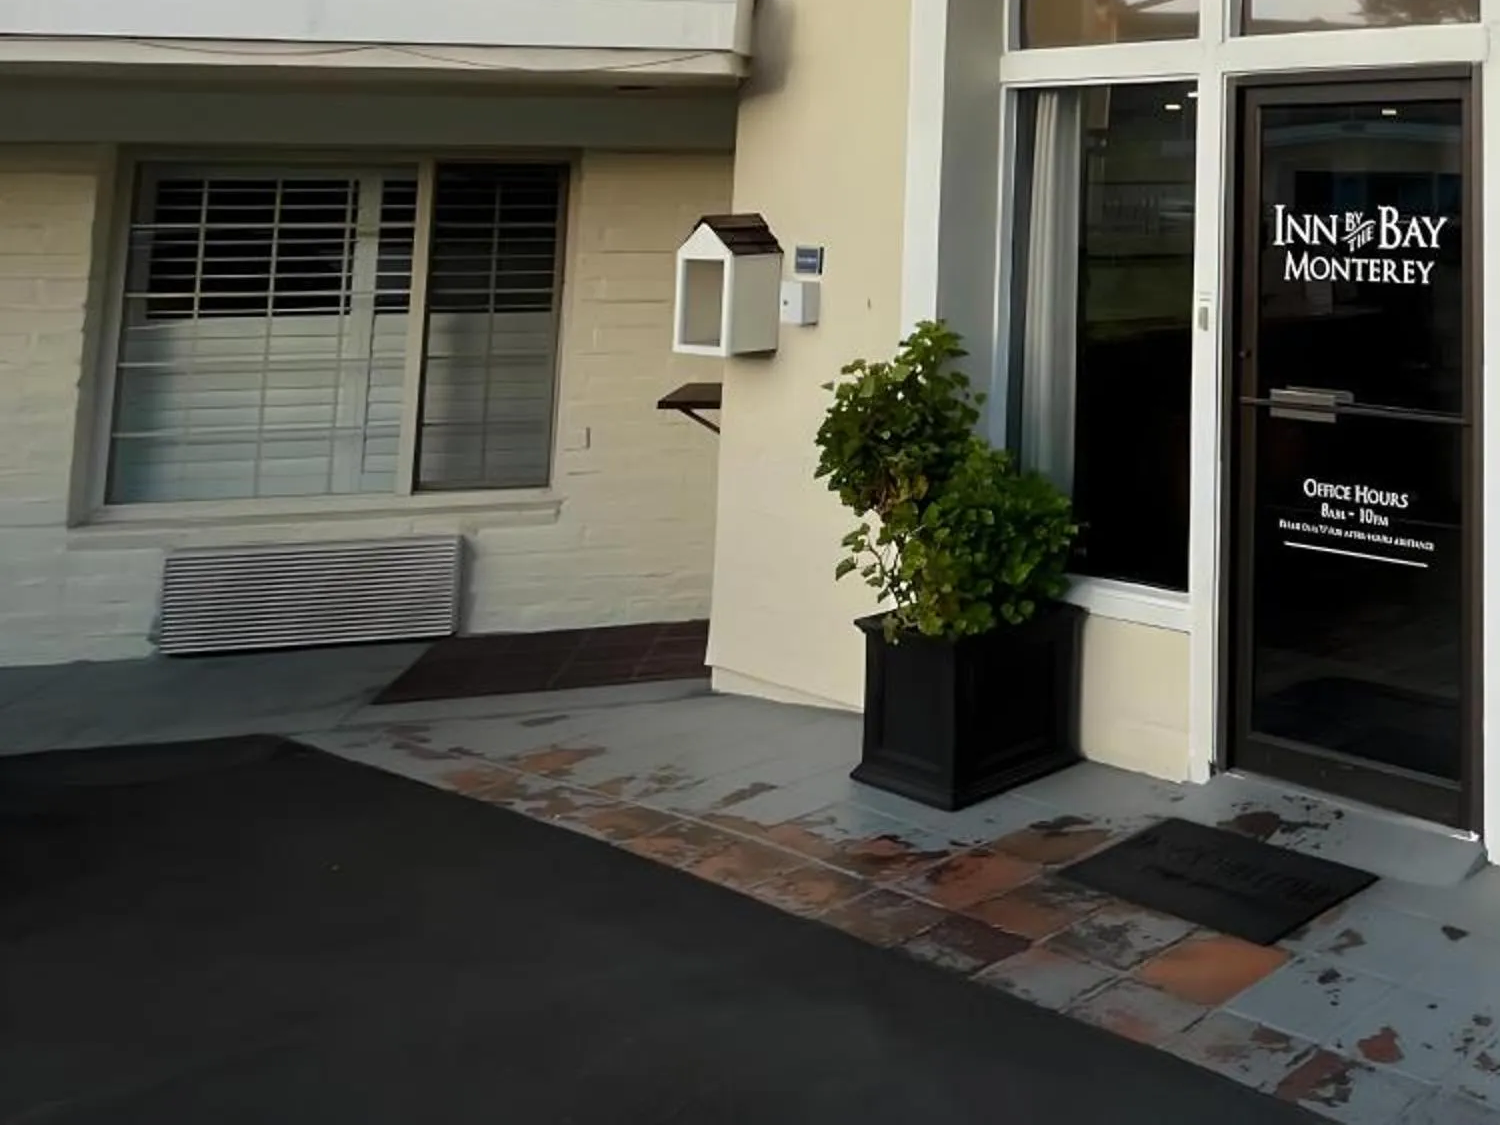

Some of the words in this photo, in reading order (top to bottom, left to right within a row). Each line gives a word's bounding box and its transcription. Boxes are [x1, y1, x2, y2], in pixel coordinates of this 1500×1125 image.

[1273, 204, 1338, 246] INN
[1345, 211, 1364, 232] BY
[1377, 205, 1448, 249] BAY
[1347, 225, 1374, 252] THE
[1284, 250, 1435, 285] MONTEREY
[1303, 478, 1352, 501] OFFICE
[1354, 484, 1409, 508] HOURS
